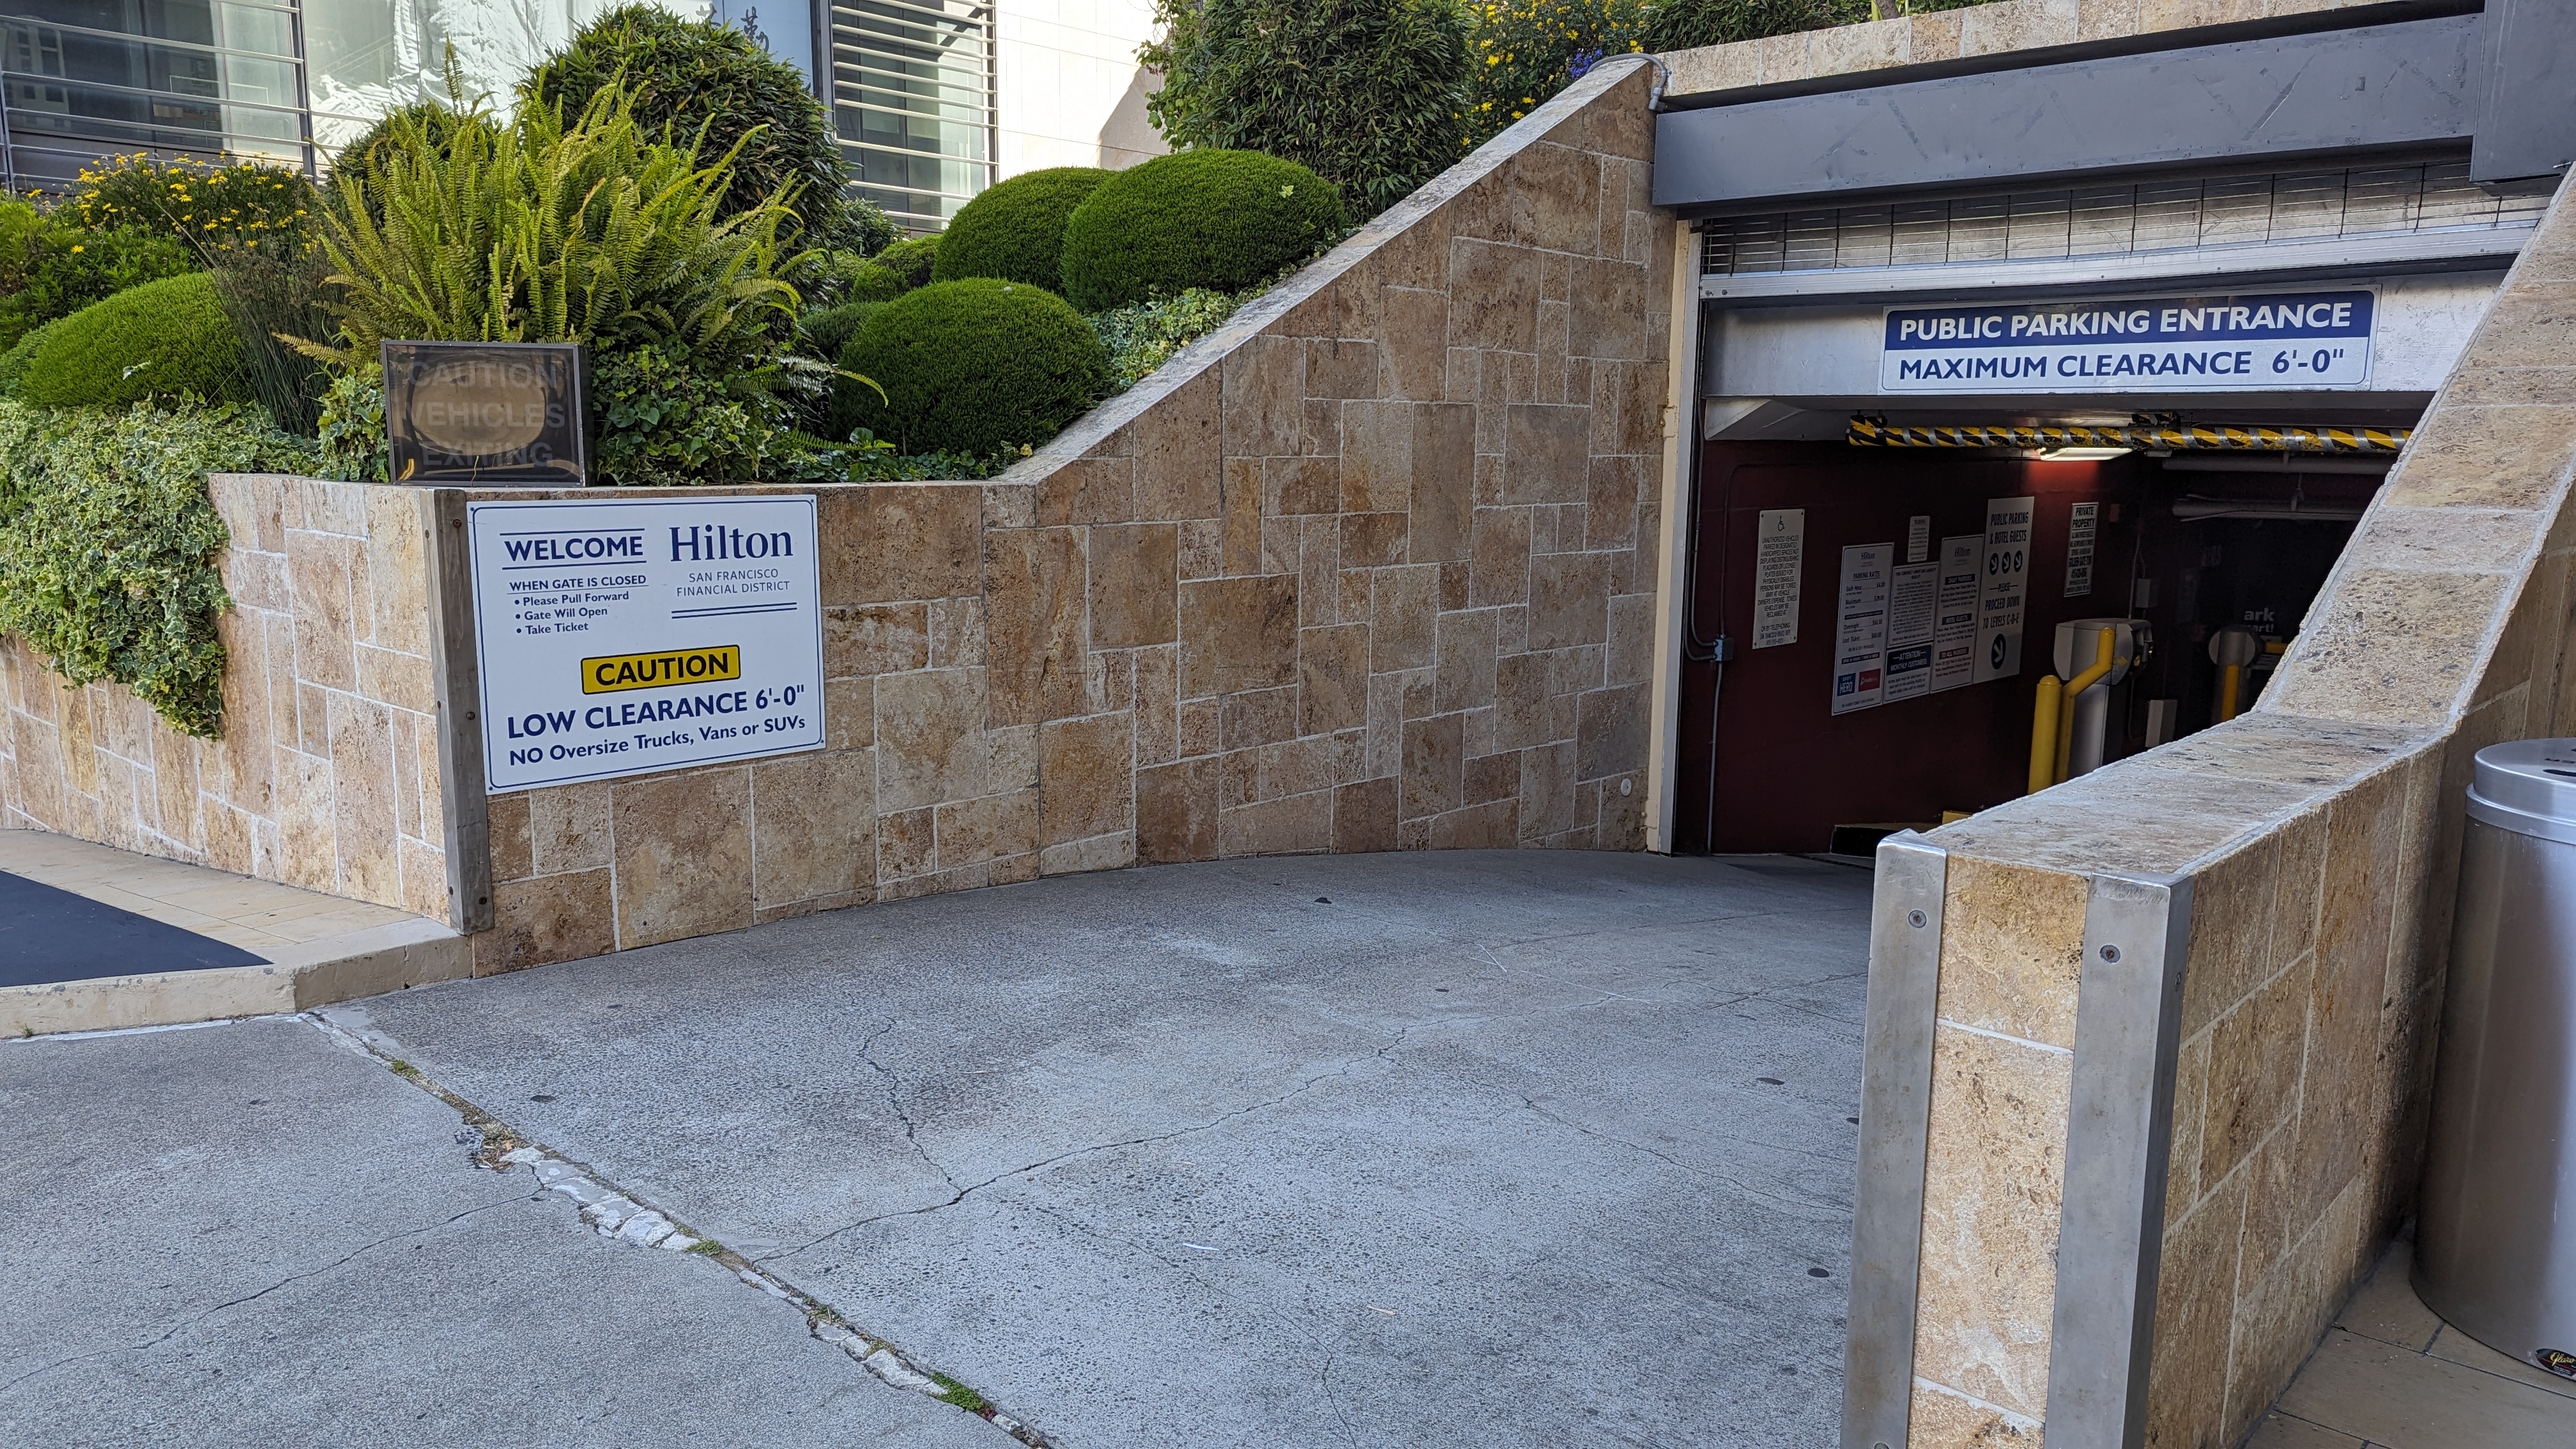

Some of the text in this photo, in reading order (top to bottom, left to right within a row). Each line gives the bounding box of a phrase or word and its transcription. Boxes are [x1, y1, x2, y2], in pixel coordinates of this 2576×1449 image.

[1899, 302, 2352, 341] PUBLIC PARKING ENTRANCE
[1899, 355, 2046, 381] MAXIMUM
[2056, 351, 2251, 377] CLEARANCE
[410, 361, 557, 389] CAUTION
[407, 401, 565, 429] VEHICLES
[422, 441, 553, 468] EXITING
[1990, 512, 2029, 526] PUBLIC PARKING
[2075, 506, 2094, 516] PRIVATE
[2072, 518, 2095, 528] PROPERTY
[669, 524, 793, 562] Hilton
[1994, 531, 2009, 544] HOTEL
[2009, 529, 2027, 542] GUESTS
[504, 535, 644, 563] WELCOME
[1954, 547, 1970, 557] Hilton
[509, 574, 647, 592] WHEN GATE IS CLOSED
[688, 568, 779, 583] SAN FRANCISCO
[676, 580, 790, 597] FINANCIAL DISTRICT
[1997, 582, 2011, 592] PLEASE
[523, 590, 629, 607] Please Pull Forward
[1984, 595, 2020, 611] PROCEED DOWN
[524, 606, 608, 621] Gate Will Open
[525, 620, 589, 635] Take Ticket
[1982, 618, 1989, 629] TO
[1989, 615, 2005, 628] LEVELS
[1899, 650, 1921, 661] ATTENTION
[595, 652, 729, 687] CAUTION
[1839, 681, 1853, 694] HERO
[507, 709, 576, 740] LOW
[585, 691, 748, 729] CLEARANCE
[509, 715, 806, 766] NO Oversize Trucks, Vans or SUVs
